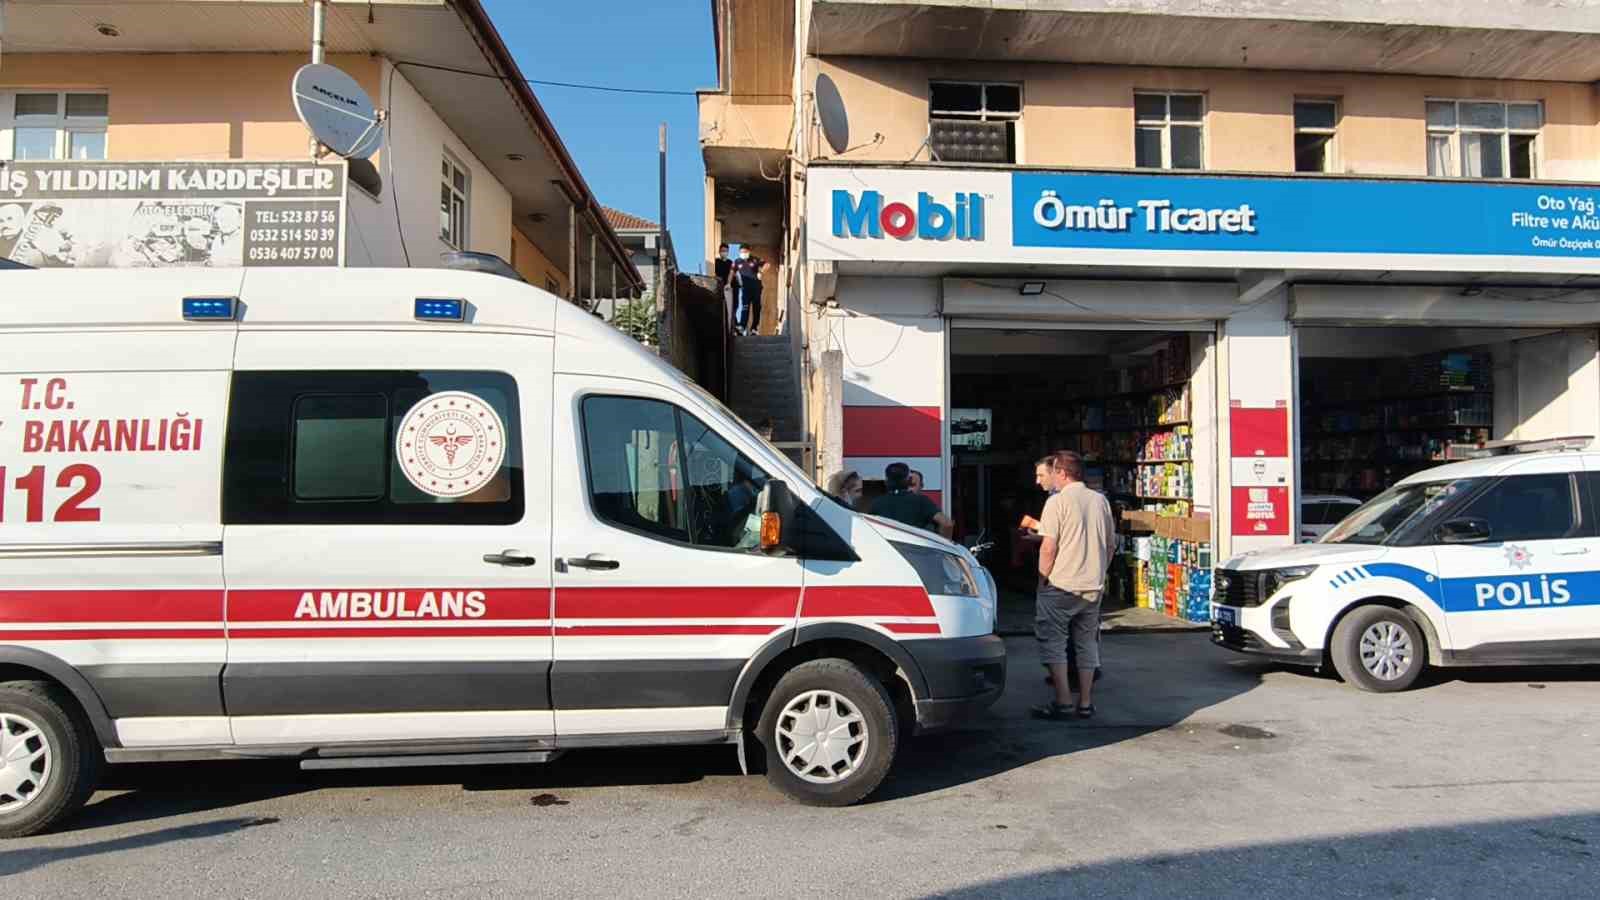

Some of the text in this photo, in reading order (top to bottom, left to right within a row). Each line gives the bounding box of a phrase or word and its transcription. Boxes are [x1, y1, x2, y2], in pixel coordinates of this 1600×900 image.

[34, 169, 161, 192] YILDIRIM
[167, 168, 335, 197] KARDEŞLER
[255, 210, 335, 223] TEL: 523 87 56
[832, 189, 985, 242] Mobil
[1033, 189, 1257, 234] Ömür Ticaret
[1537, 194, 1596, 216] Oto Yağ
[1511, 211, 1600, 231] Filtre ve Akü
[250, 229, 335, 242] 0532 514 50 39
[1531, 235, 1558, 249] Ömür
[249, 247, 334, 260] 0536 407 57 00
[20, 378, 75, 411] T.C.
[22, 411, 204, 453] BAKANLIĞI
[0, 463, 102, 523] 12
[294, 590, 487, 618] AMBULANS
[1475, 574, 1571, 608] POLİS
